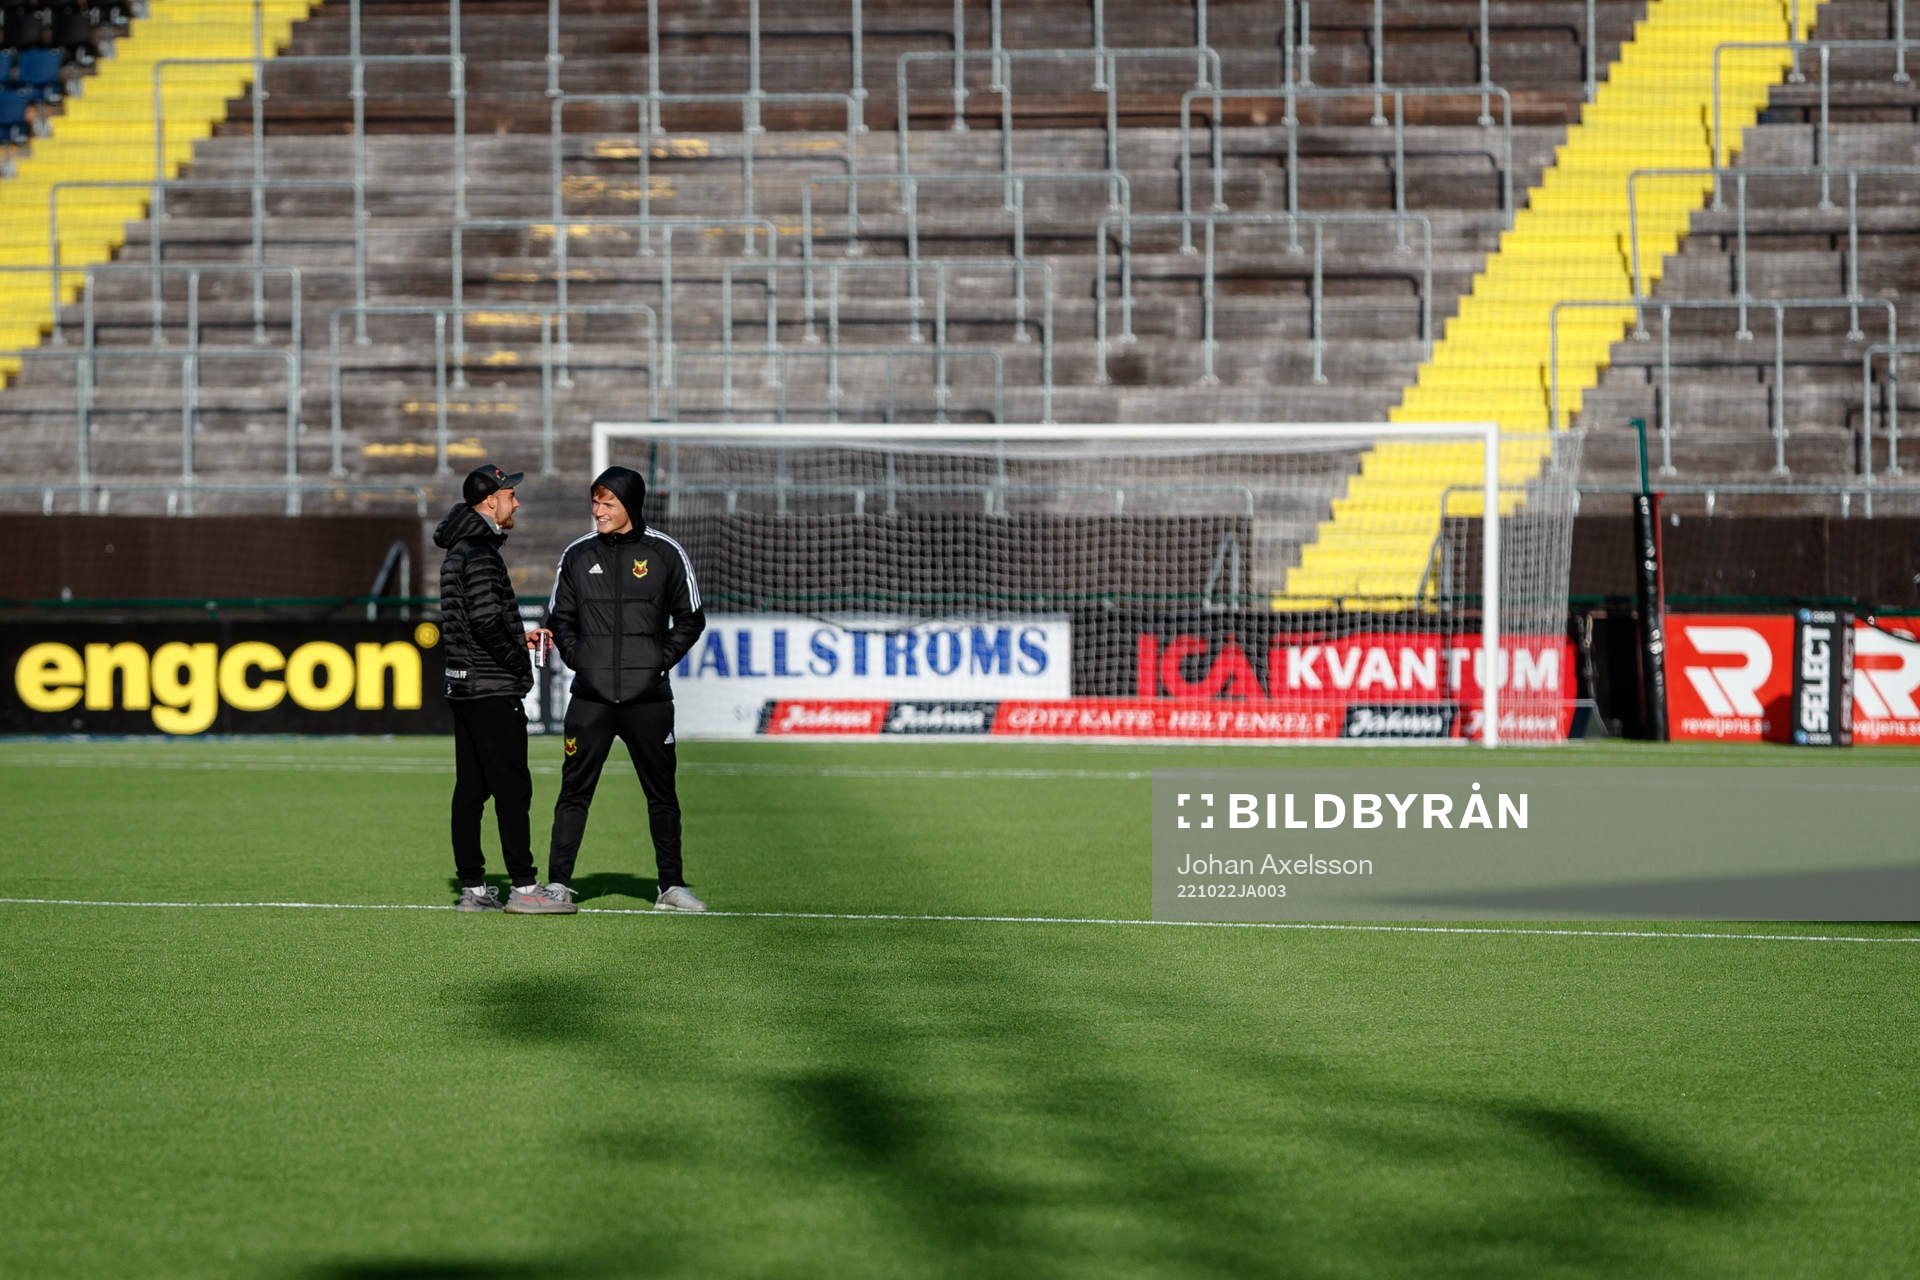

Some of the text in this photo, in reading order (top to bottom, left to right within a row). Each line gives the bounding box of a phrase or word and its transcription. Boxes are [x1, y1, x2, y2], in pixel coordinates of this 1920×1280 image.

[14, 641, 423, 735] engcon
[1137, 632, 1560, 698] ICA KVANTUM
[1801, 624, 1831, 732] SELECT
[1007, 707, 1077, 729] GOTT
